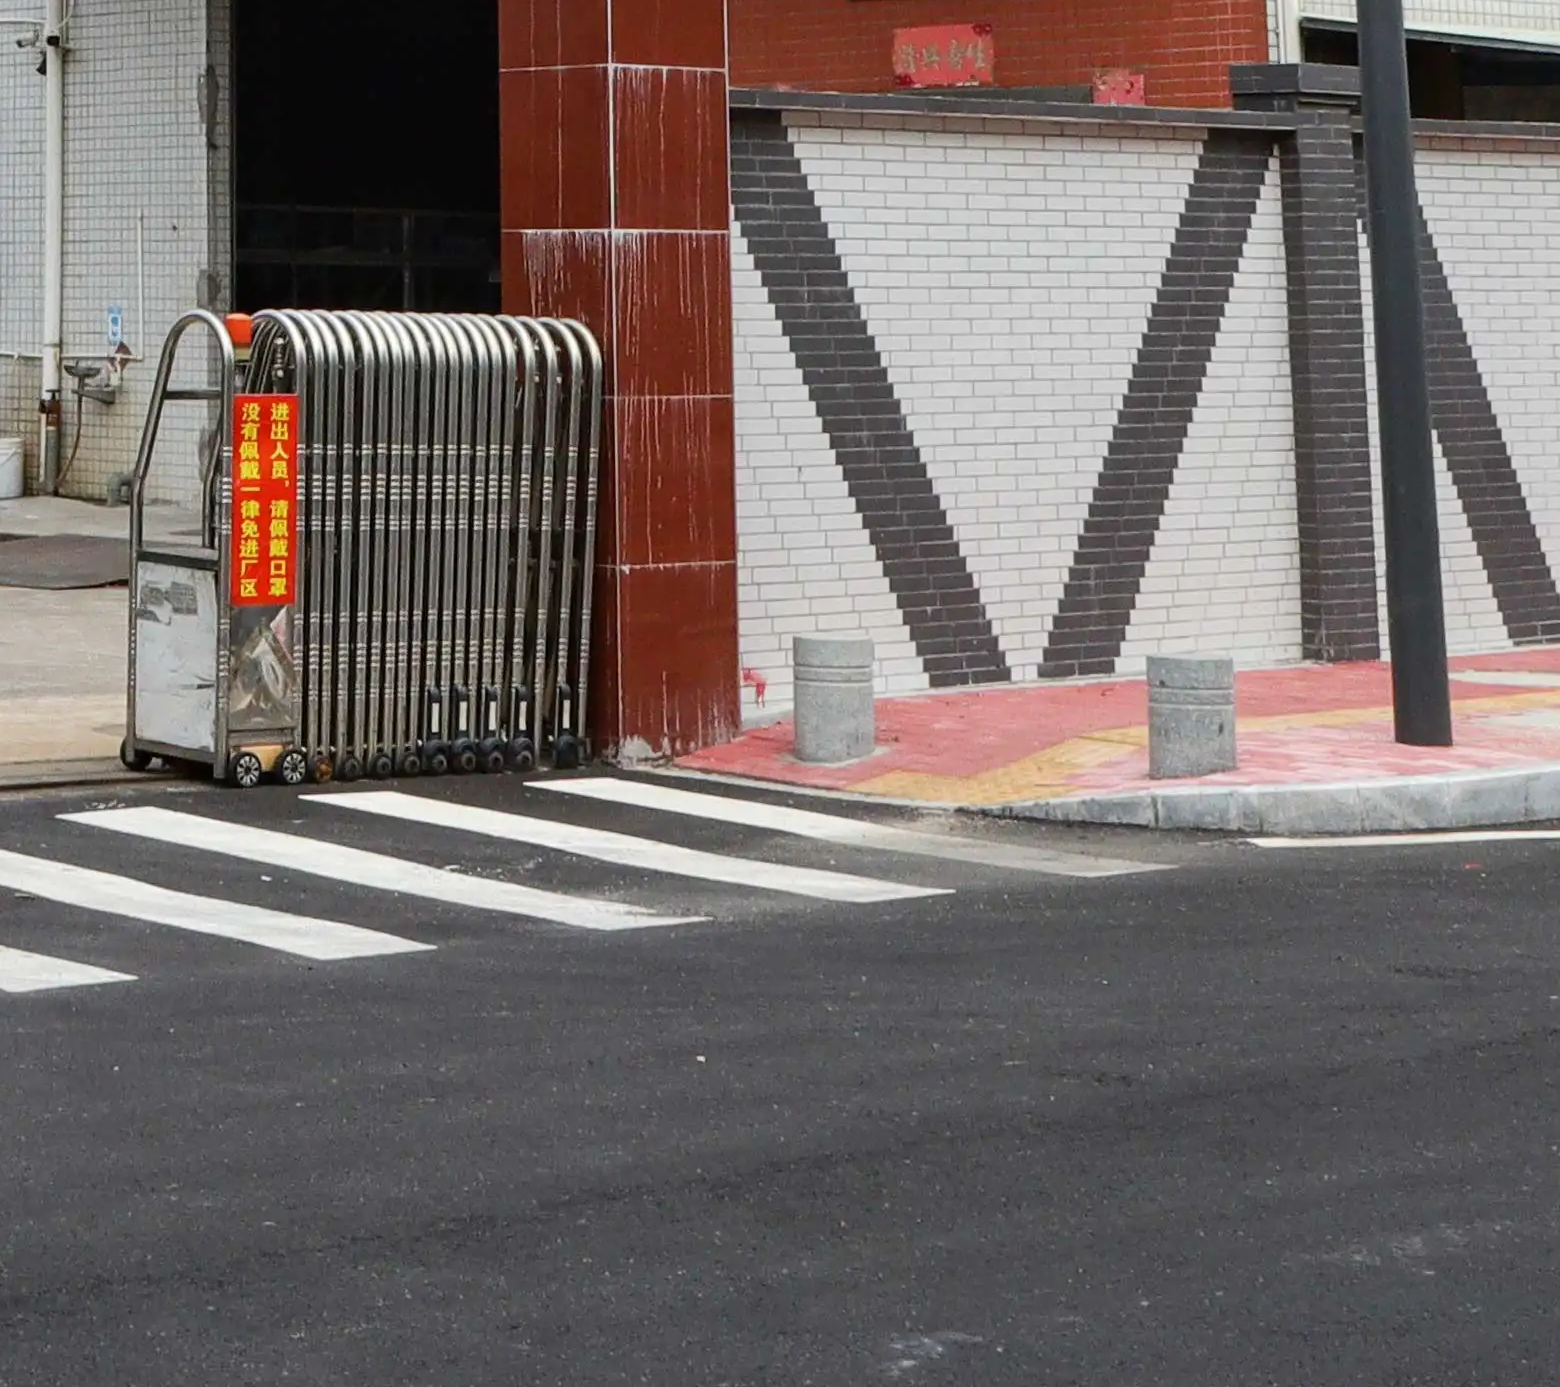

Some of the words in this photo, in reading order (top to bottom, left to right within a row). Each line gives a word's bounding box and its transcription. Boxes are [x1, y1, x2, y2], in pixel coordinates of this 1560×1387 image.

[239, 403, 262, 597] 没有佩戴一律免进厂区
